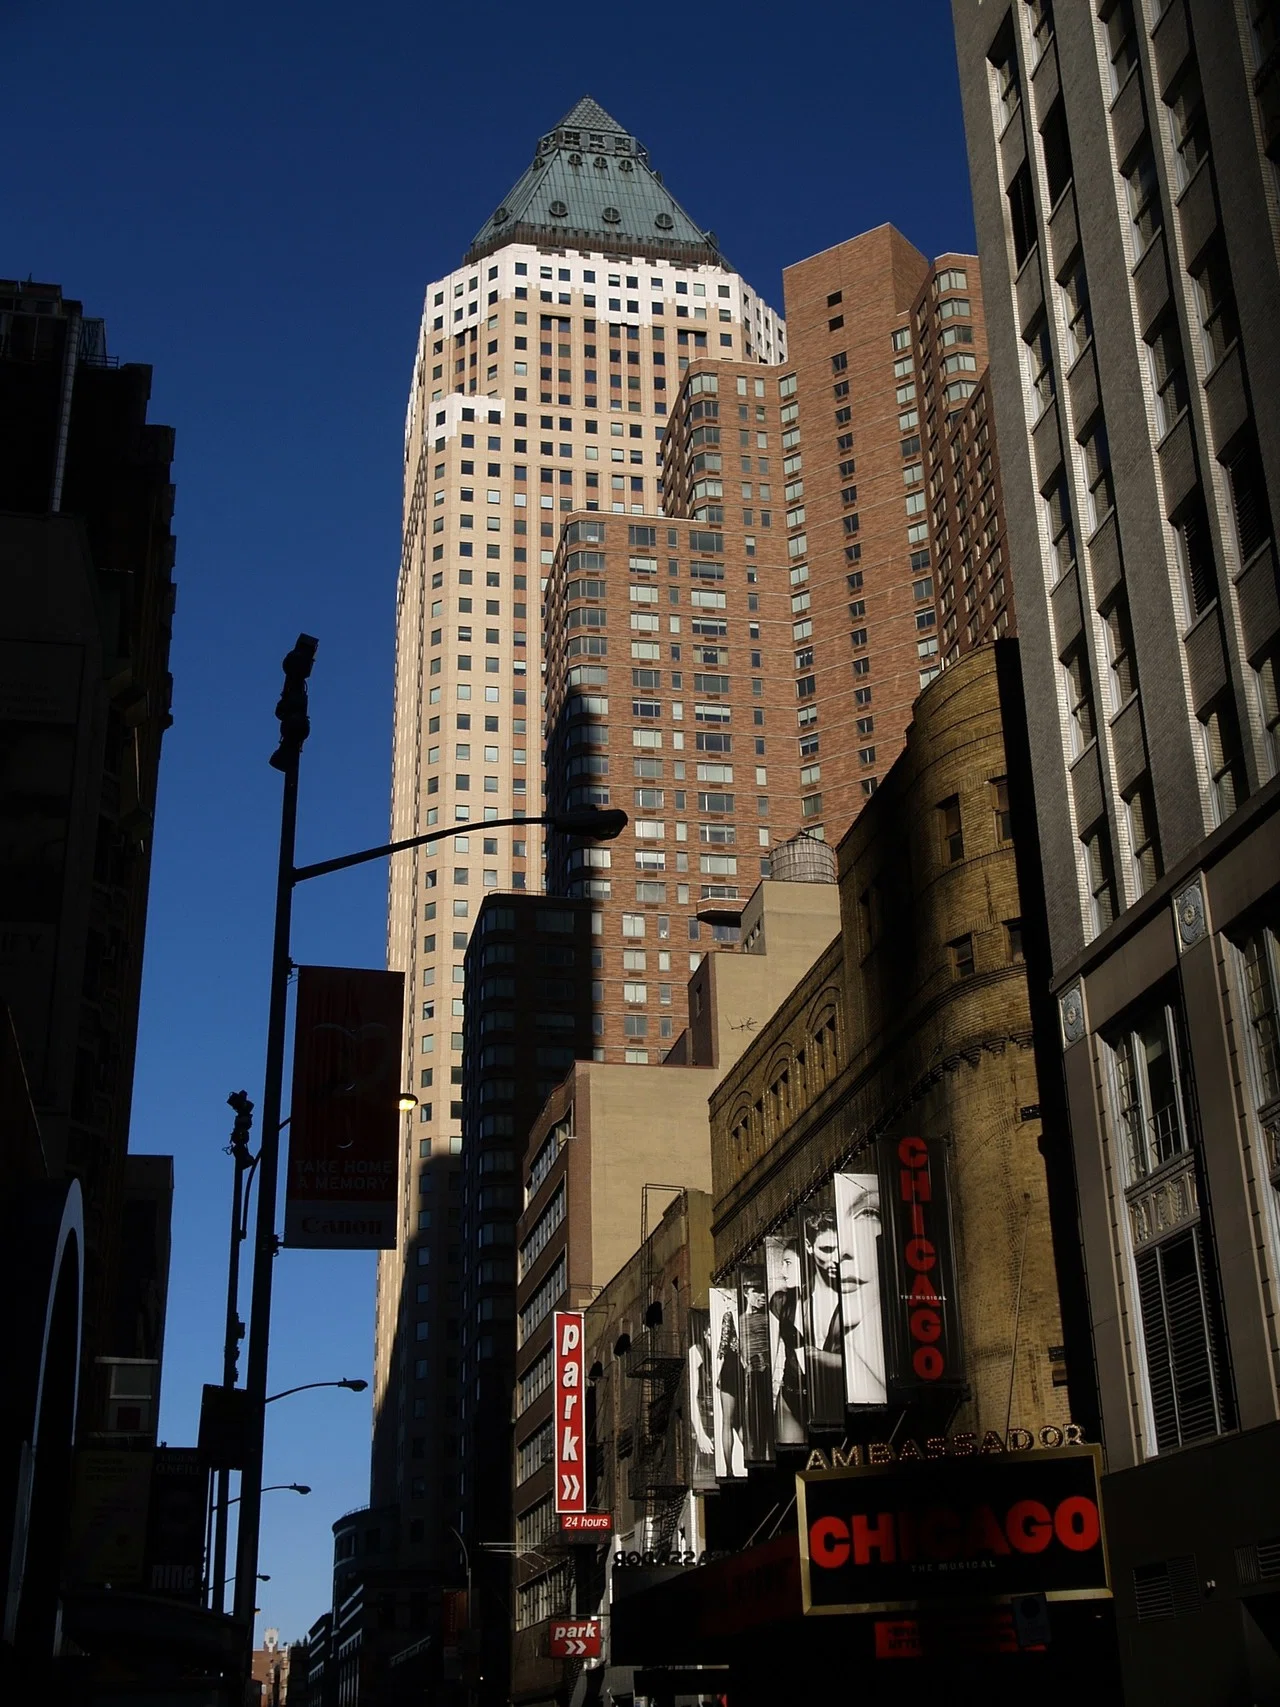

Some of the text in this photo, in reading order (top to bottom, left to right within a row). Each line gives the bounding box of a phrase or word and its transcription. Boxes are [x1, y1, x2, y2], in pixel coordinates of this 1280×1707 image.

[294, 1159, 393, 1174] TAKE HOME
[298, 1176, 389, 1190] A MEMORY
[301, 1216, 383, 1236] Canon
[897, 1135, 944, 1381] CHICAGO
[561, 1322, 580, 1463] park
[805, 1422, 1086, 1472] AMBASSADOR
[564, 1515, 609, 1528] 24 hours
[809, 1495, 1100, 1569] CHICAGO
[152, 1561, 195, 1590] nine
[911, 1559, 997, 1574] THE MUSICAL
[554, 1623, 597, 1641] park
